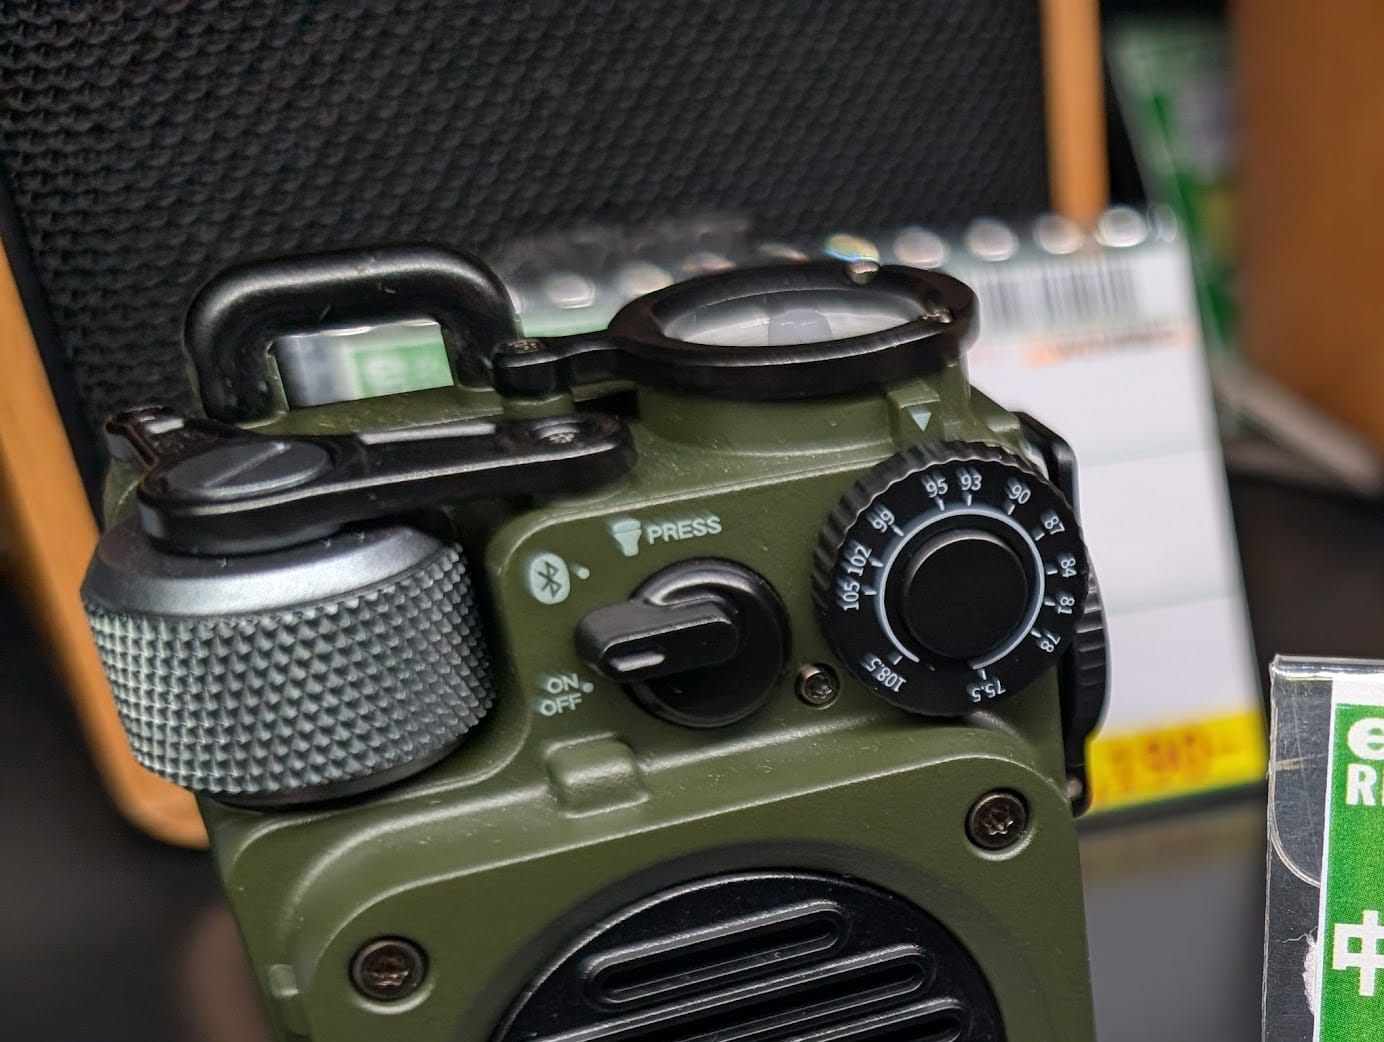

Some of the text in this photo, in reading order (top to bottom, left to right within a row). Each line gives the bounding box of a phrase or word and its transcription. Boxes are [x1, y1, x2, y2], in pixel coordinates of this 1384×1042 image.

[926, 477, 948, 498] 95
[961, 475, 983, 491] 93
[1008, 484, 1031, 504] 90
[647, 516, 722, 545] PRESS
[872, 510, 895, 532] 99
[1044, 515, 1065, 535] 87
[848, 545, 872, 577] 102
[1060, 557, 1077, 578] 84
[843, 581, 860, 611] 105
[1057, 595, 1075, 615] 81
[1040, 632, 1061, 653] 78
[546, 673, 580, 694] ON
[866, 658, 907, 692] 108.5
[971, 679, 1007, 703] 75.5
[540, 694, 583, 717] OFF
